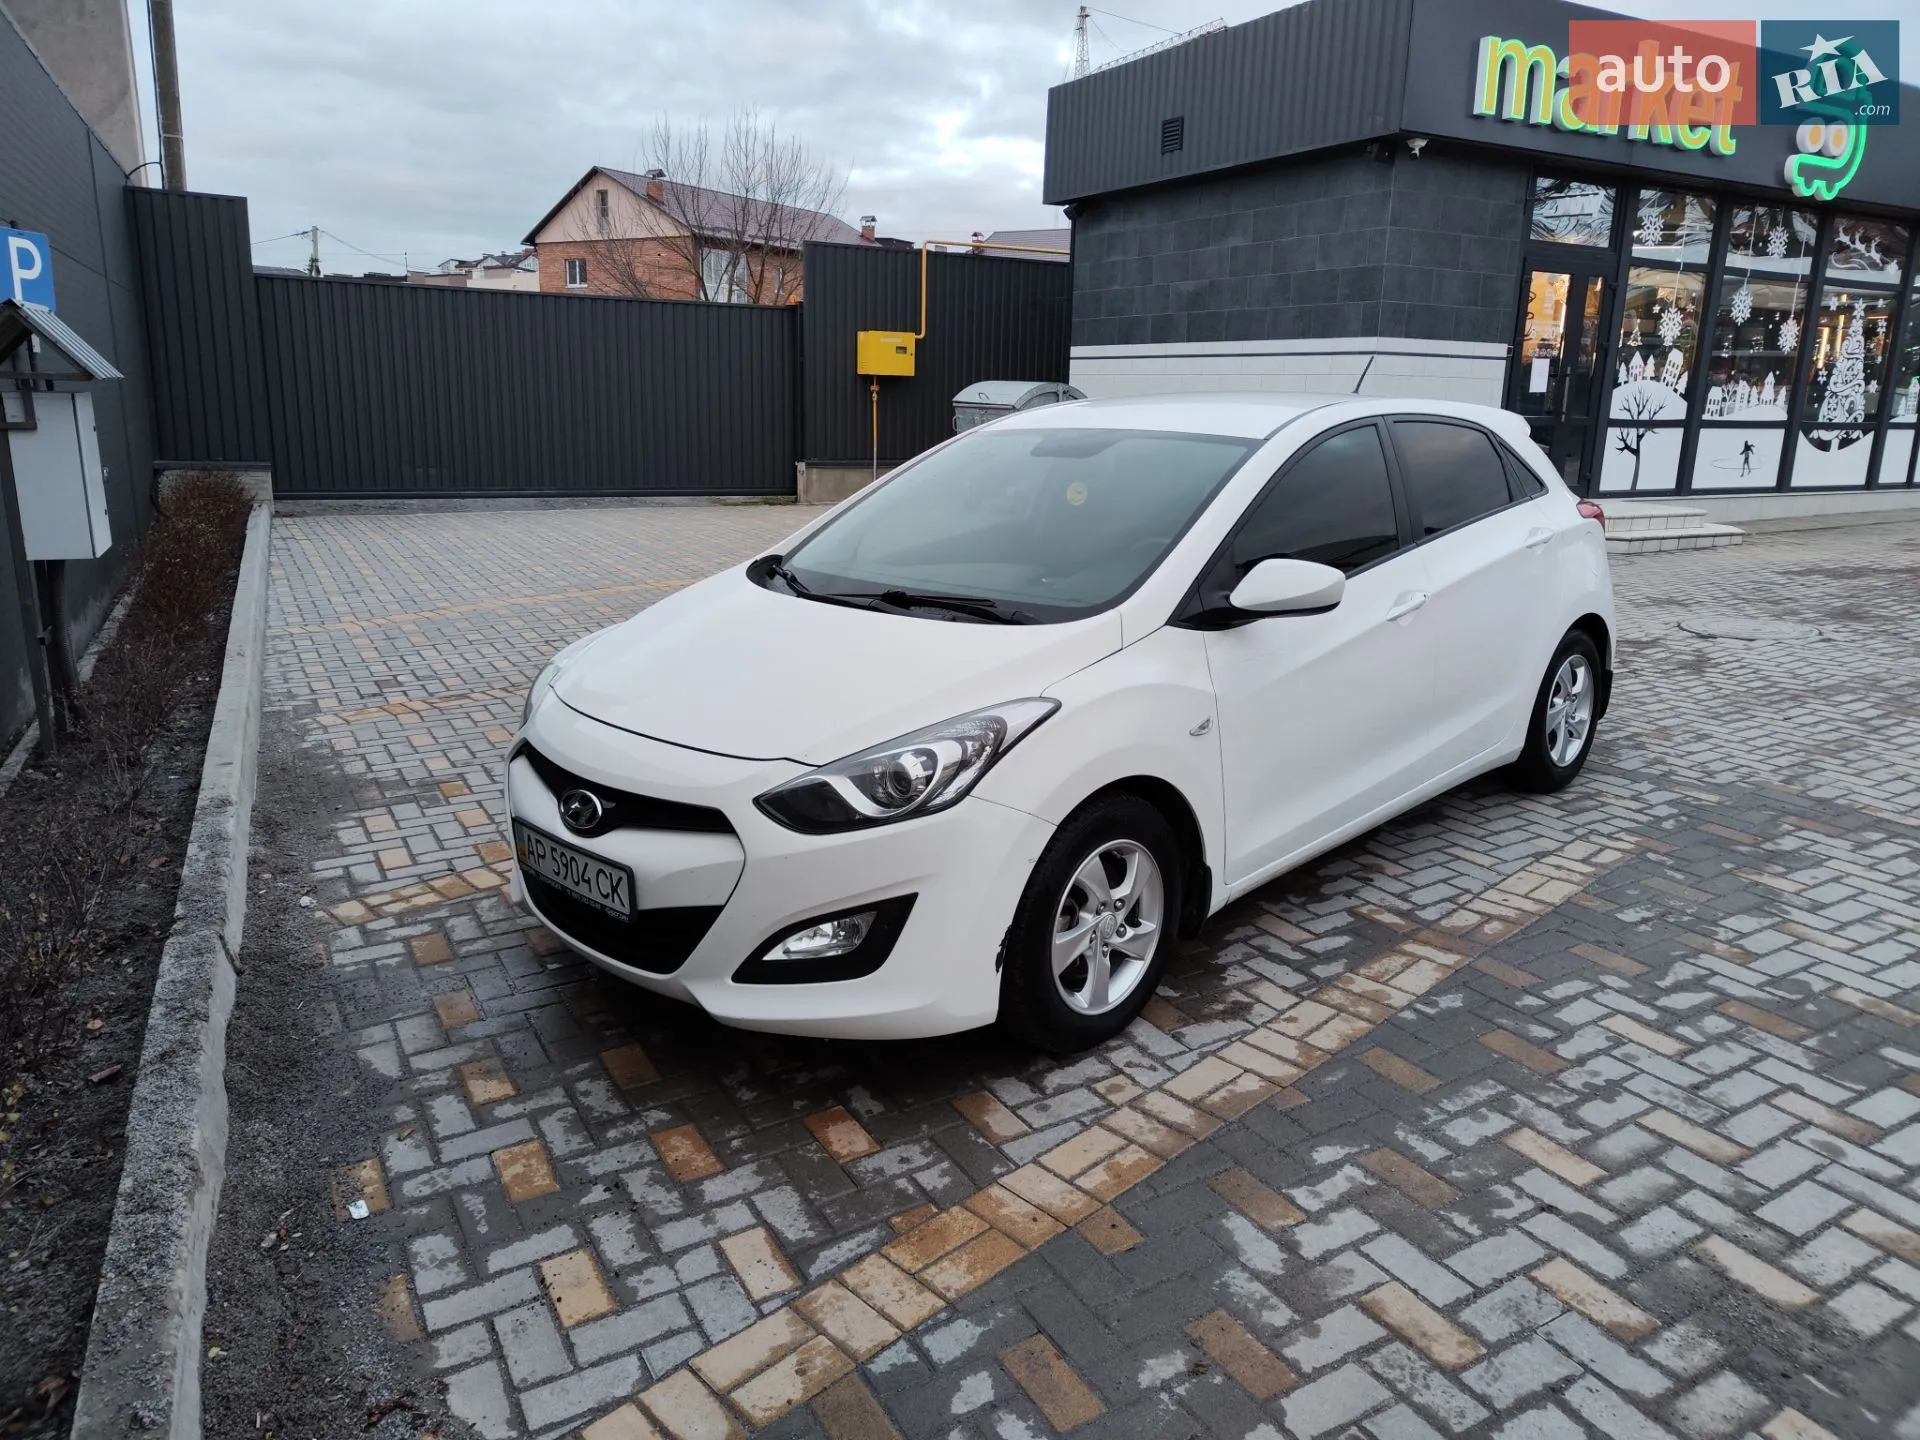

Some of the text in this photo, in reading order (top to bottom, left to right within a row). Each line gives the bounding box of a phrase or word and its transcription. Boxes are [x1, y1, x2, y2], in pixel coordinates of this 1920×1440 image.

[8, 235, 43, 302] P
[526, 834, 547, 867] AP
[551, 847, 593, 893] 5904
[595, 868, 627, 909] CK
